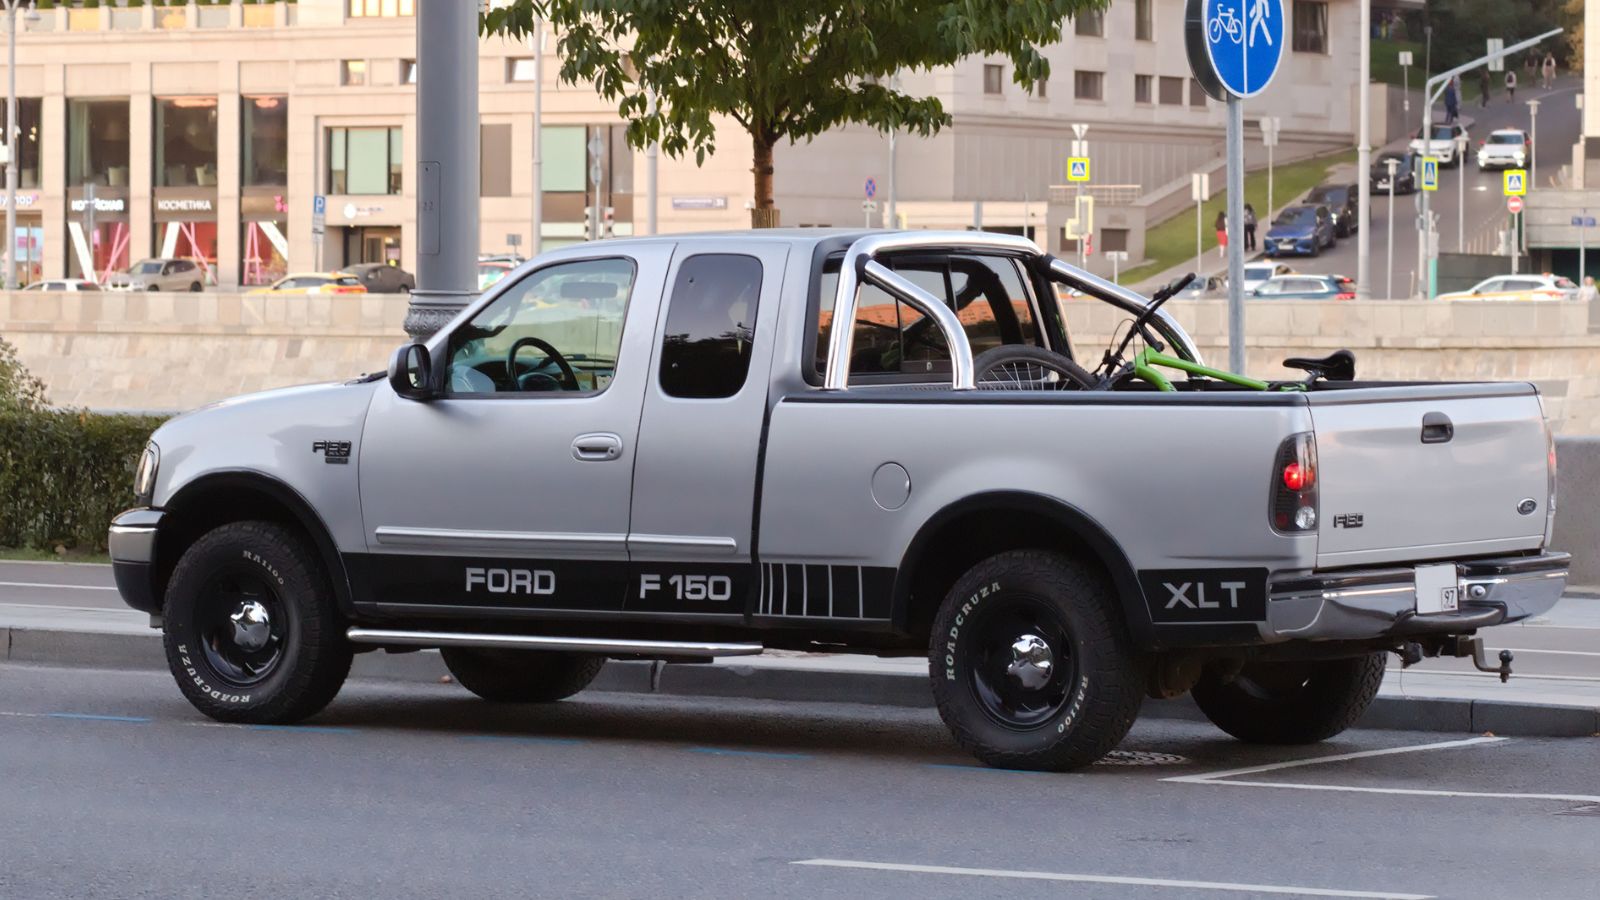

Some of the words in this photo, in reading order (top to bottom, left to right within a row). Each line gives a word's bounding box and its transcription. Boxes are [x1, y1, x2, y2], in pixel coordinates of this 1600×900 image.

[71, 198, 125, 211] КОЙСКАЯ
[157, 200, 212, 210] КОСМЕТИКА
[465, 567, 556, 595] FORD
[639, 573, 661, 599] F
[668, 574, 732, 601] 150
[1162, 581, 1247, 609] XLT
[1444, 589, 1455, 605] 97
[945, 582, 1001, 681] ROADCRUZA
[178, 644, 251, 703] ROADCRUZA
